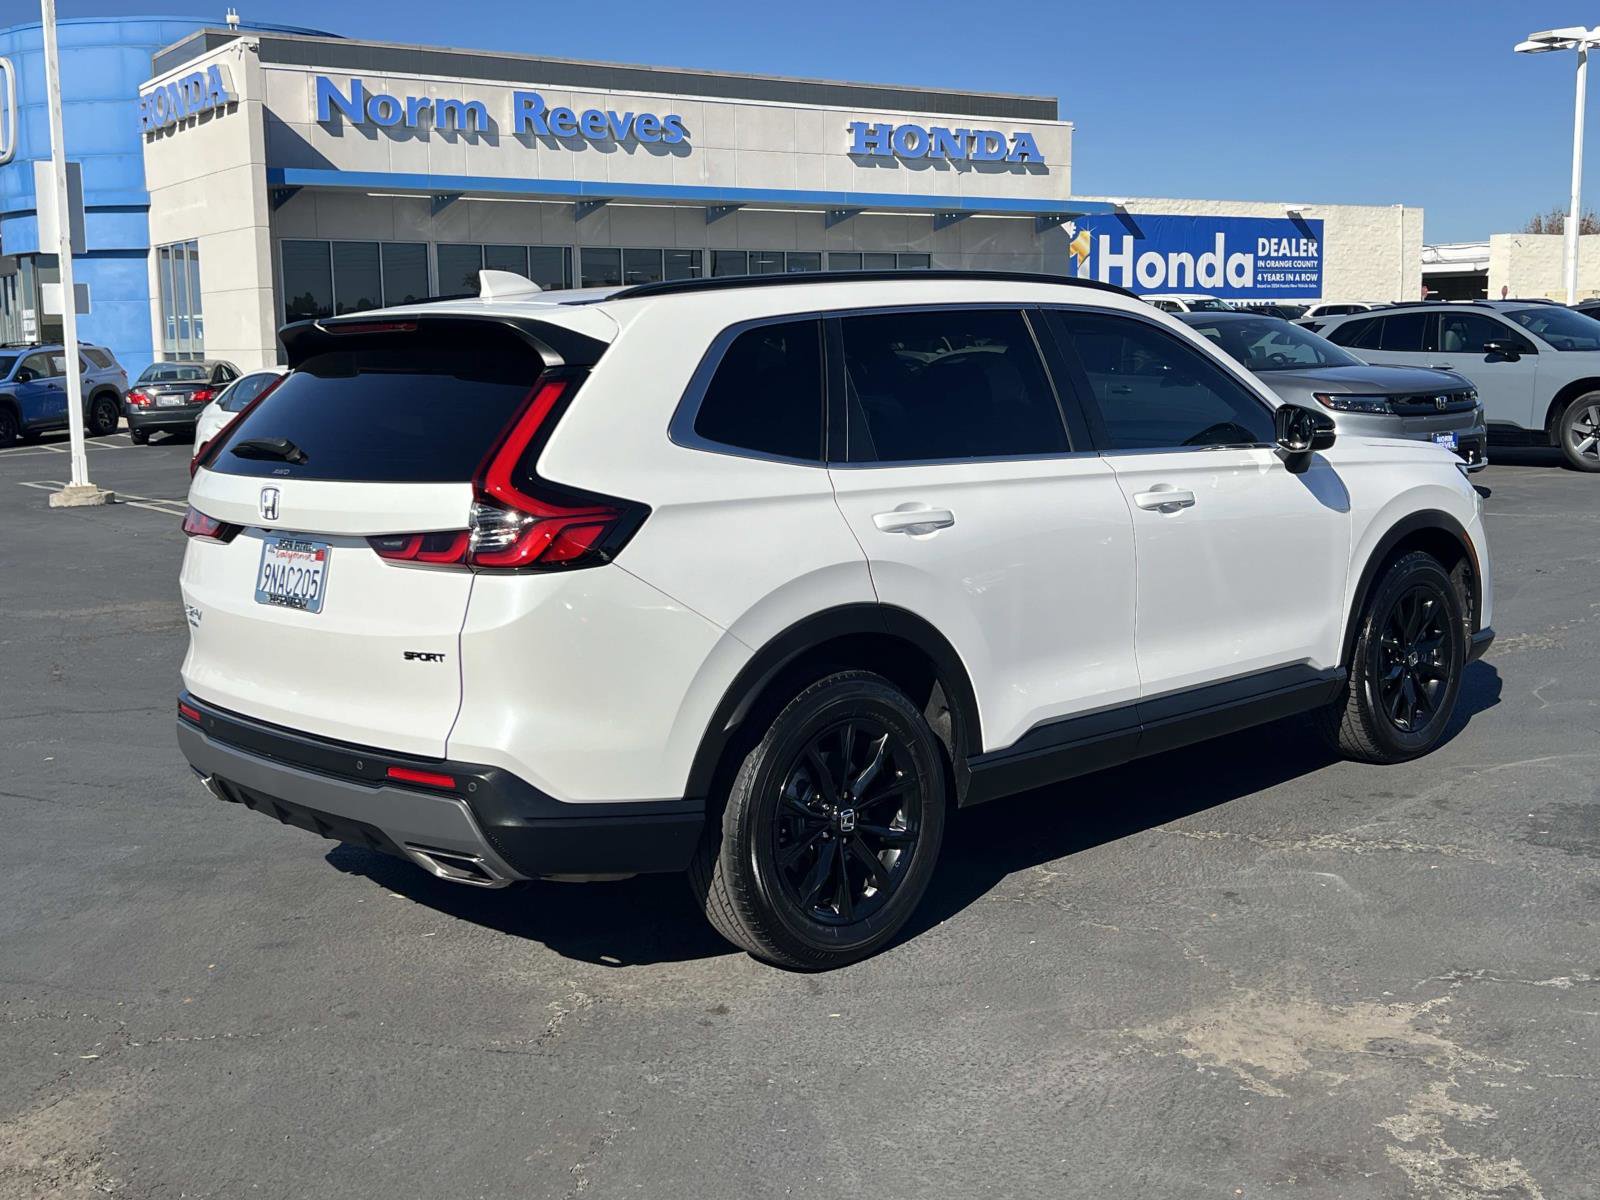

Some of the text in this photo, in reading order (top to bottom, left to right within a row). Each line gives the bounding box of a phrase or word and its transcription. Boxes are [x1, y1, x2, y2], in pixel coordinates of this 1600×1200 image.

[137, 64, 230, 134] HONDA
[315, 75, 684, 144] Norm Reeves
[849, 121, 1046, 164] HONDA
[1098, 231, 1255, 289] Honda
[1257, 237, 1319, 257] DEALER
[1257, 260, 1318, 268] IN ORANGE COUNTY
[1257, 273, 1318, 282] 4 YEARS IN A ROW
[262, 563, 320, 600] 9NAC205
[403, 651, 446, 663] SPORT
